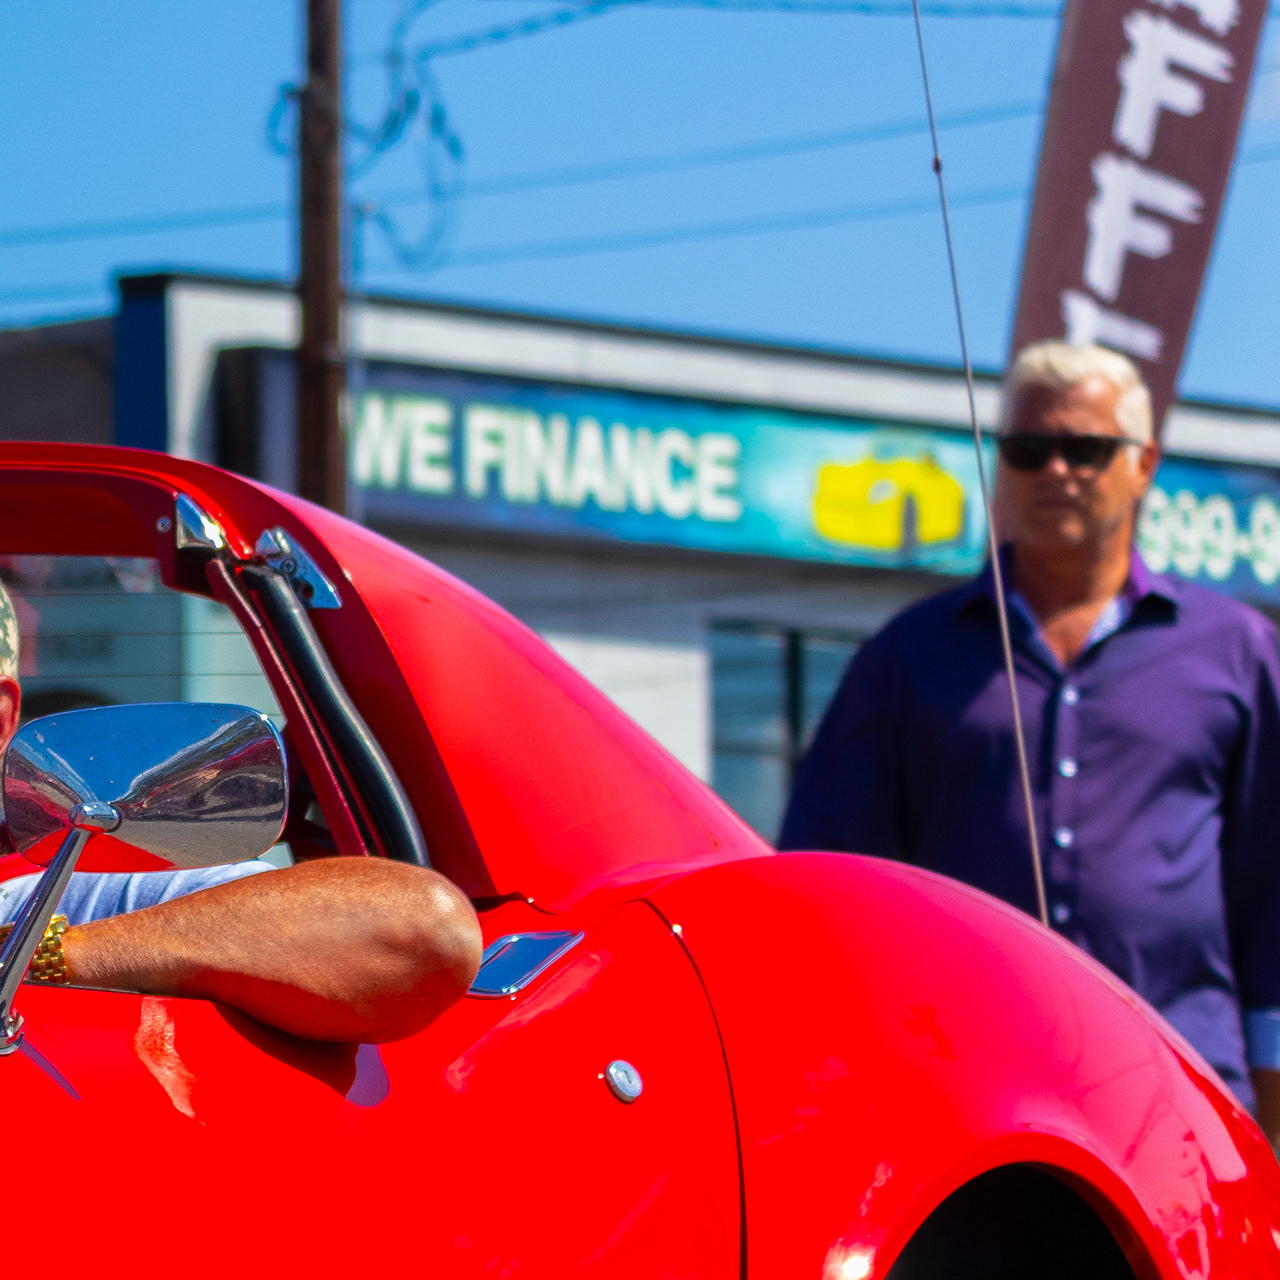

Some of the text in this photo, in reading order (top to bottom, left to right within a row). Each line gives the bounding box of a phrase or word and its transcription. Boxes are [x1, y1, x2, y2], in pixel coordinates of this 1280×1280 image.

[1060, 0, 1240, 362] FF
[353, 396, 743, 523] WE FINANCE
